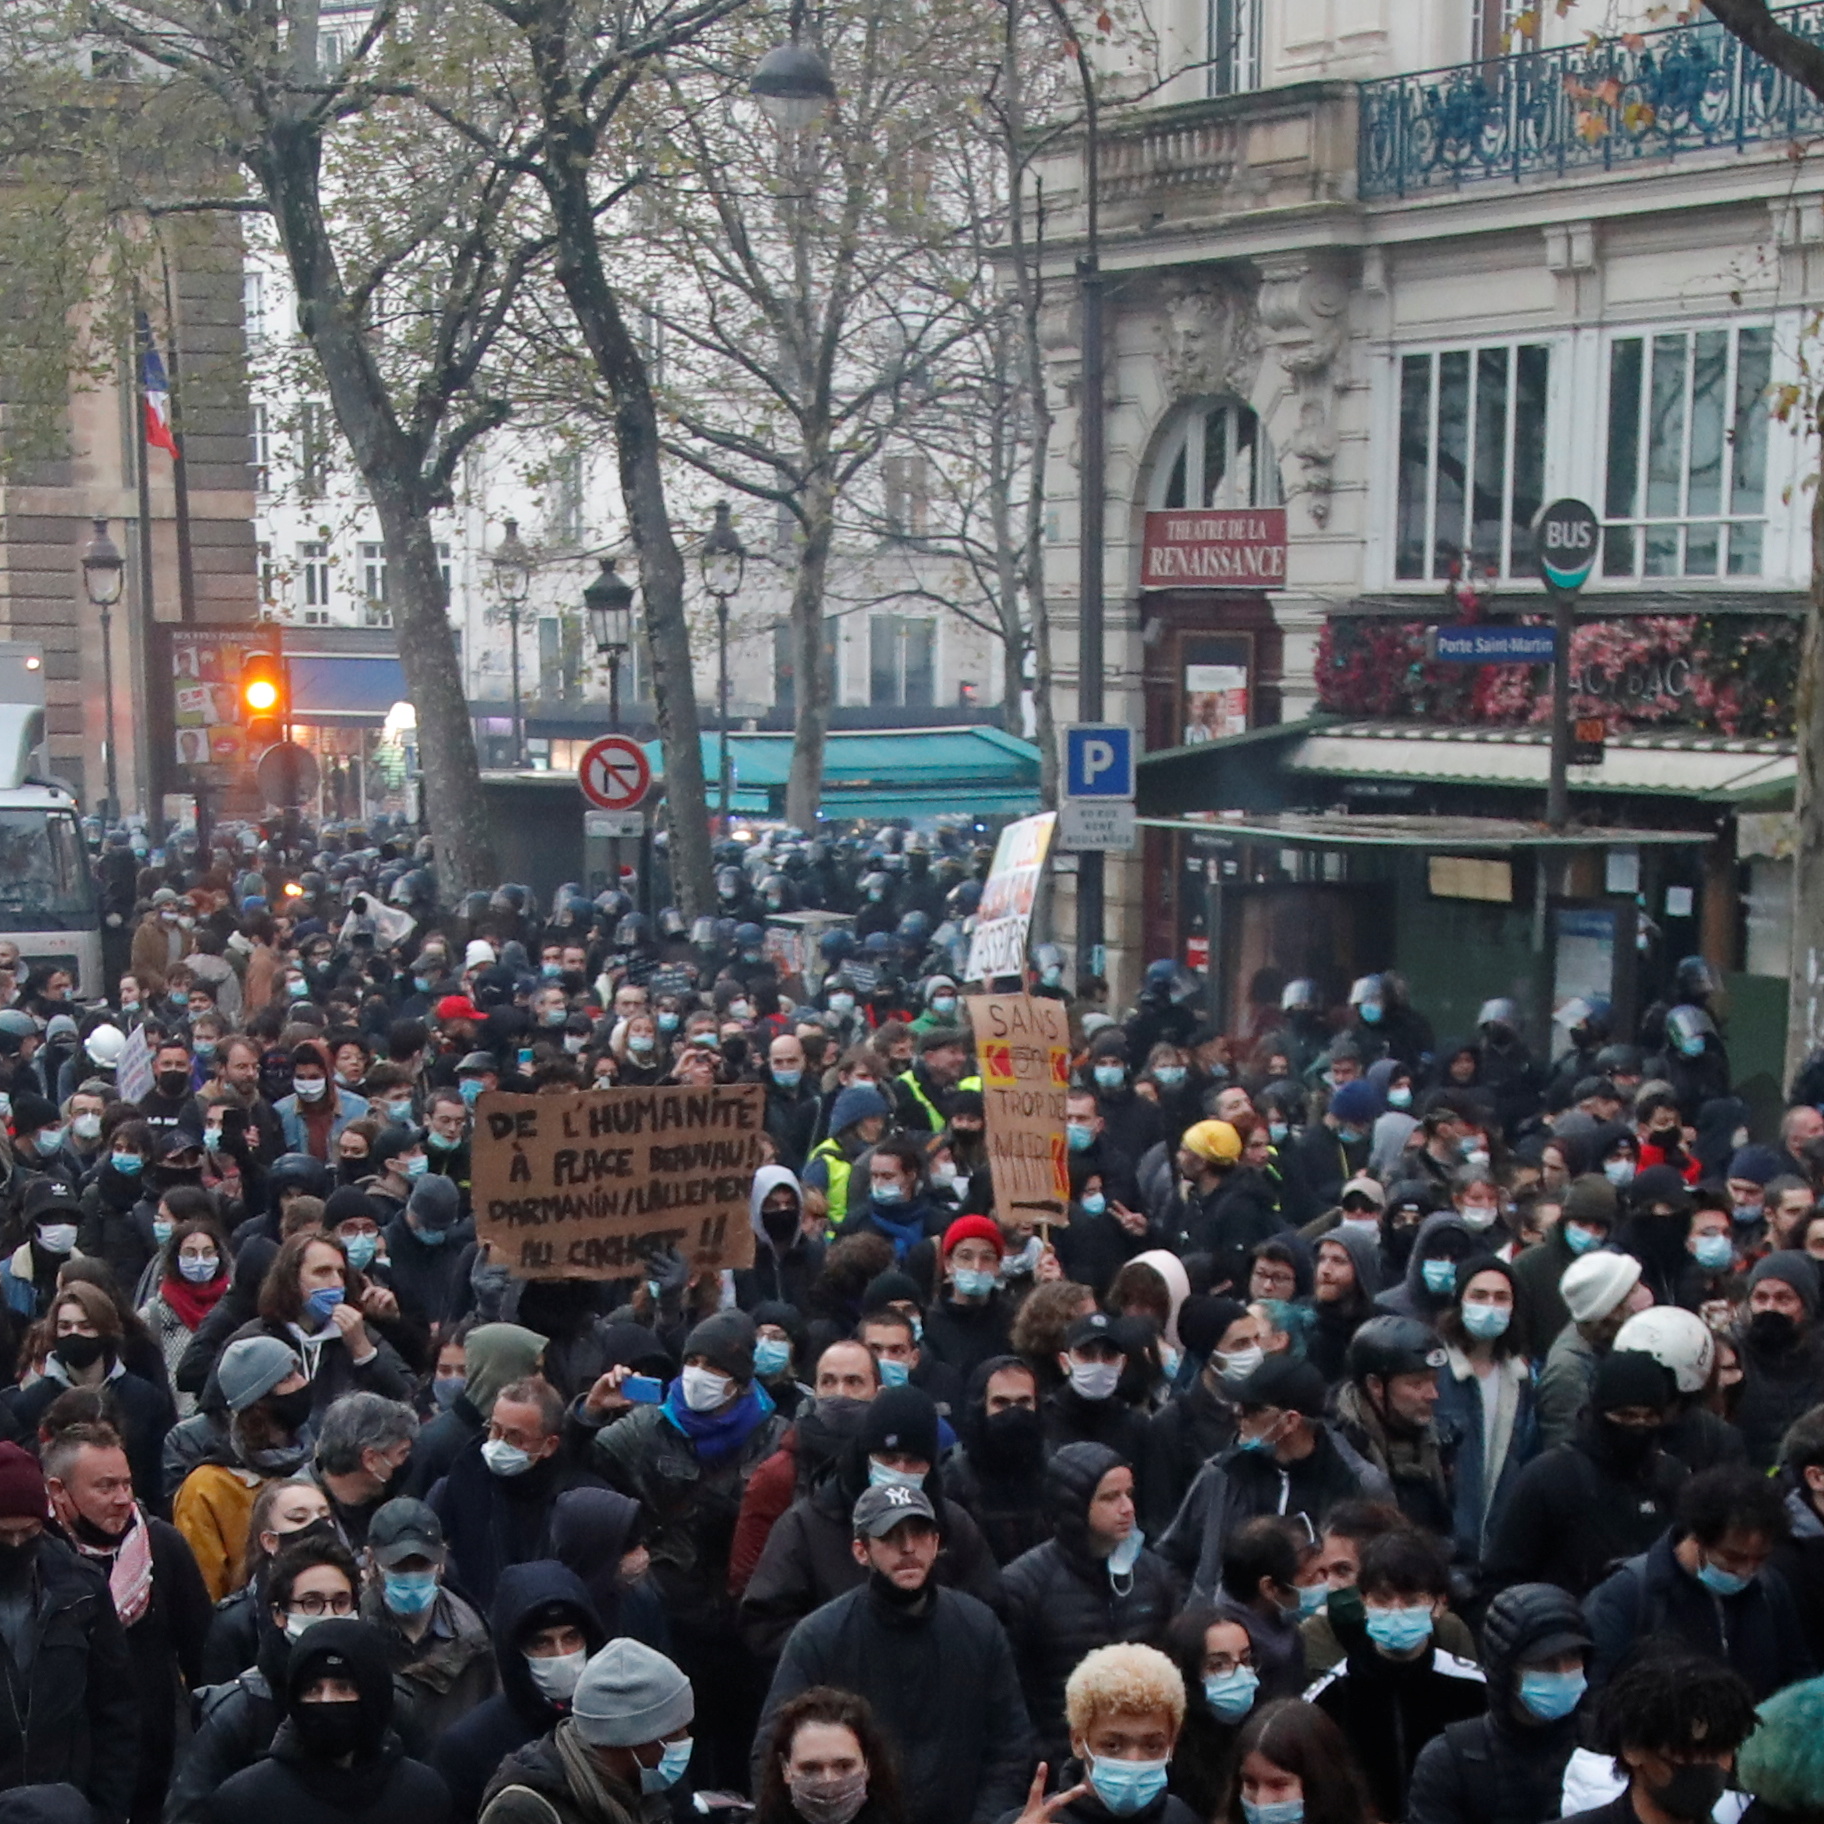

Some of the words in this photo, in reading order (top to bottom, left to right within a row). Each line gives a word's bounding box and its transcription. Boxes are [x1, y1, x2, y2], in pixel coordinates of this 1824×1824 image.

[1228, 520, 1246, 540] DE
[1248, 519, 1266, 539] LA
[1546, 521, 1592, 550] BUS
[1149, 545, 1284, 577] RENAISSANCE
[1438, 636, 1473, 656] Porte
[1475, 634, 1554, 655] Saint-Martin
[1082, 740, 1114, 785] P
[989, 1002, 1059, 1038] SANS
[993, 1088, 1044, 1119] TROP
[486, 1108, 538, 1141] DE
[508, 1140, 533, 1183] À
[553, 1147, 634, 1187] PLACE
[520, 1239, 553, 1268] AU
